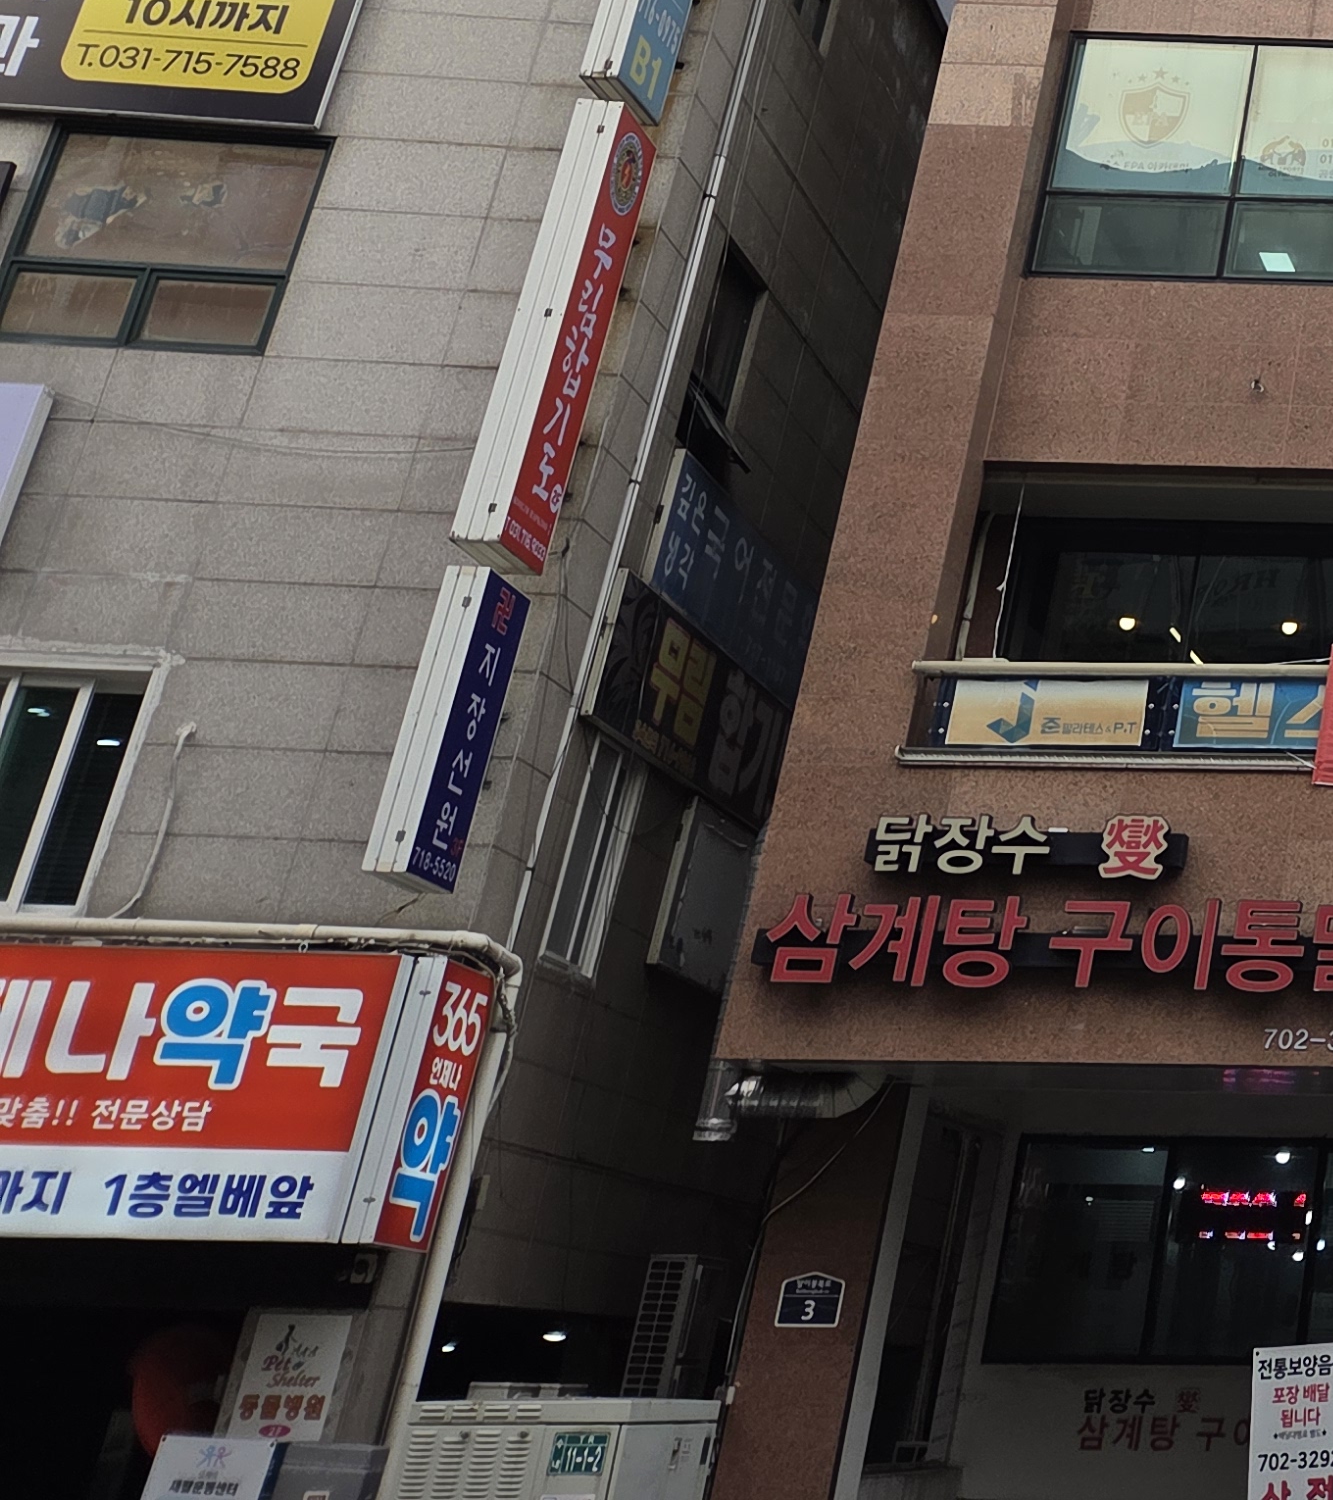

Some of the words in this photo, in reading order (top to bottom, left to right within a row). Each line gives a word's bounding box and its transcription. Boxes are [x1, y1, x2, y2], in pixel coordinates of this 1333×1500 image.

[76, 43, 301, 81] T.031-715-7588
[629, 35, 662, 100] B1
[432, 643, 500, 850] 지장선원
[873, 813, 1052, 876] 닭장수
[412, 846, 457, 884] 718-5520
[766, 893, 1028, 988] 삼계탕
[431, 981, 488, 1057] 365
[429, 1056, 463, 1092] 언제나
[90, 1098, 213, 1133] 전문상담
[801, 1300, 816, 1320] 3
[261, 1355, 291, 1373] Pet
[266, 1371, 321, 1389] Shelter
[239, 1393, 326, 1421] 동물병원
[1083, 1388, 1155, 1413] 닭장수
[1273, 1385, 1299, 1405] 포장
[1303, 1383, 1330, 1403] 배달
[1077, 1415, 1180, 1451] 삼계탕
[1280, 1407, 1321, 1428] 됩니다
